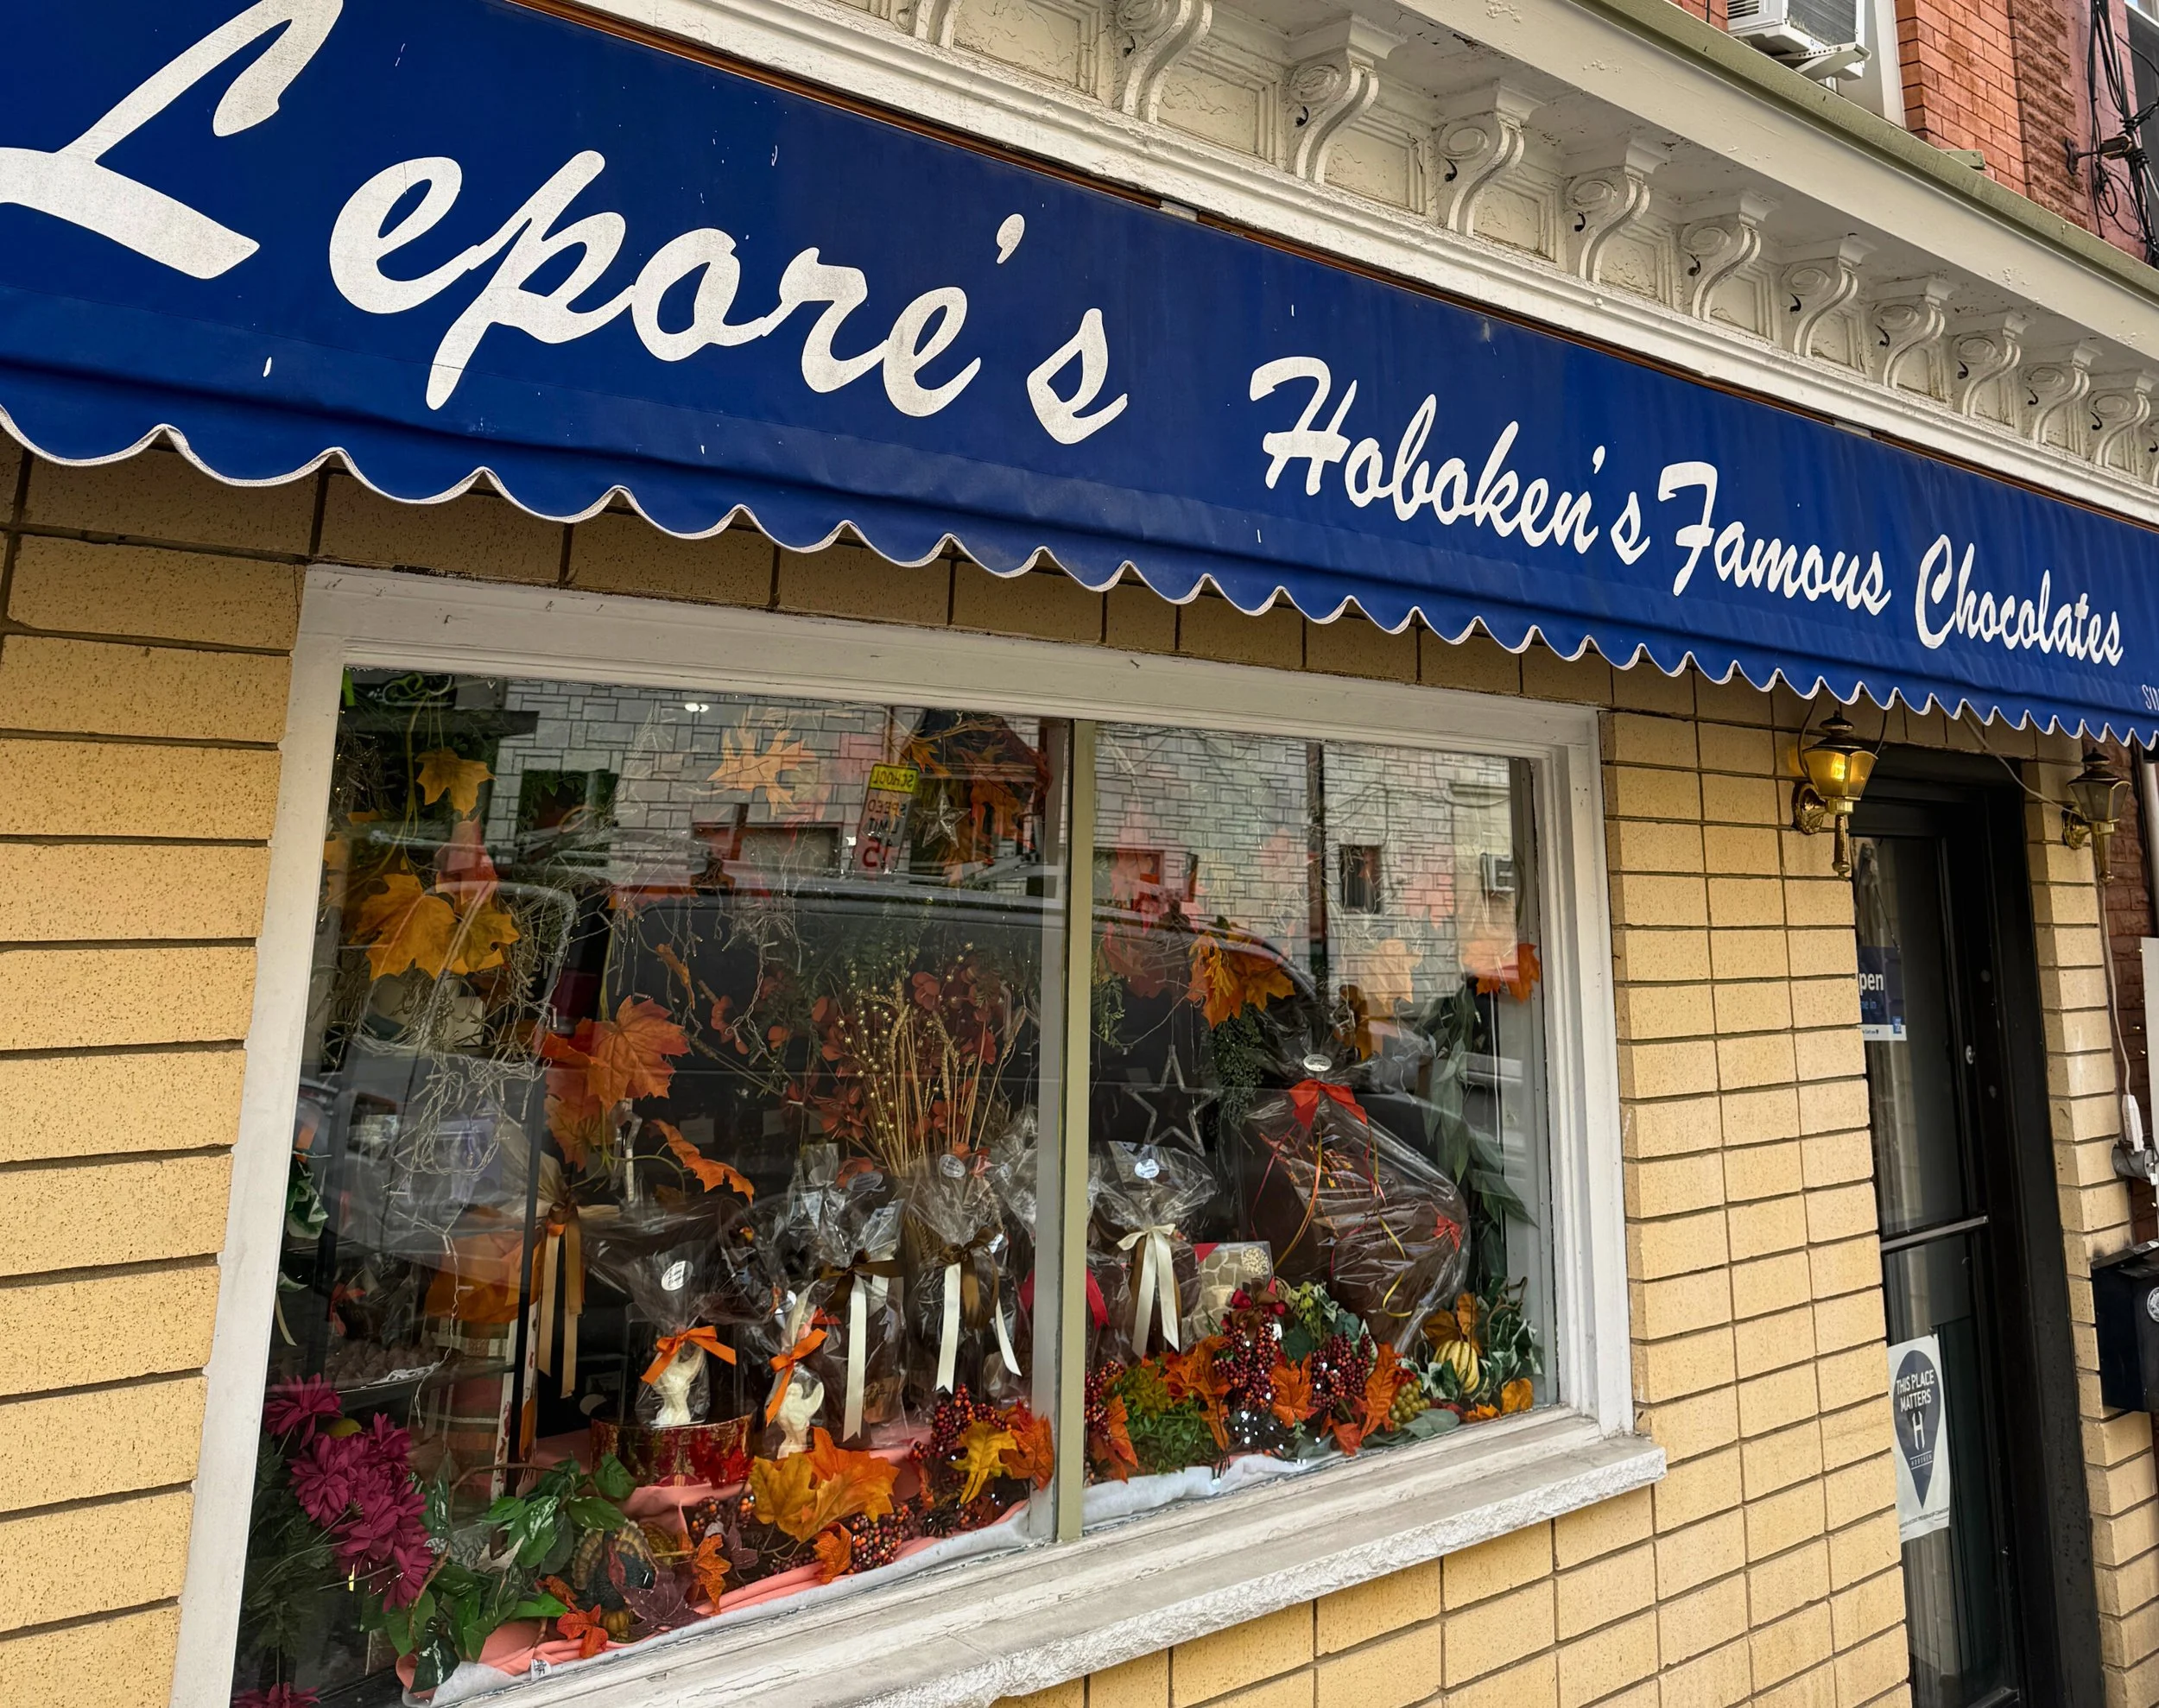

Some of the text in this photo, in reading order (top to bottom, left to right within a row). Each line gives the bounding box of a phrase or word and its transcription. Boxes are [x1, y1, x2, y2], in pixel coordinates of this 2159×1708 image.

[0, 0, 2124, 667] Lepore's Hoboken's Famous Chocolates
[1858, 972, 1884, 996] pen
[1896, 1370, 1934, 1395] THIS PLACE
[1901, 1389, 1932, 1412] MATTERS
[1912, 1410, 1925, 1451] H
